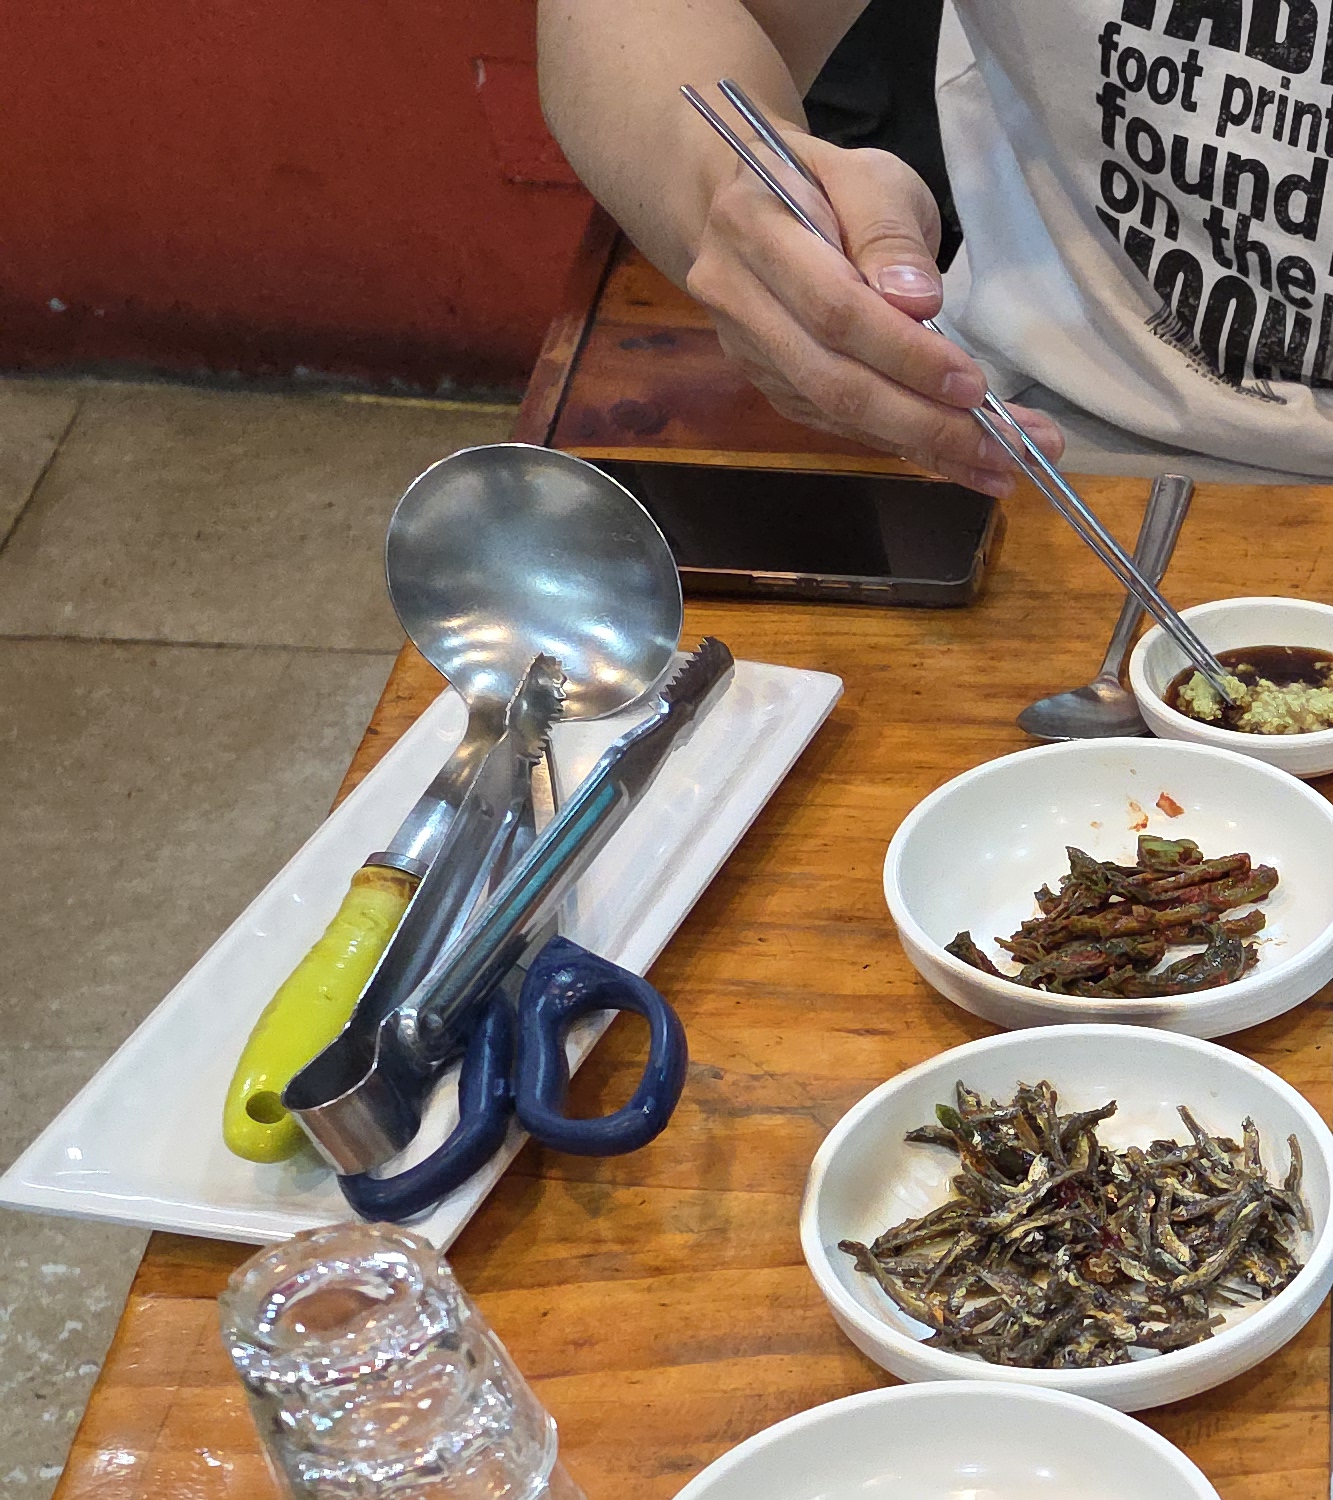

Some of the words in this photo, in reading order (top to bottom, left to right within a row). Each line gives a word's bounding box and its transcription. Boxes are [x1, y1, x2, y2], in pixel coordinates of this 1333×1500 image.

[1098, 21, 1203, 112] foot
[1096, 82, 1329, 241] found
[1101, 160, 1179, 241] on
[1203, 205, 1317, 309] the
